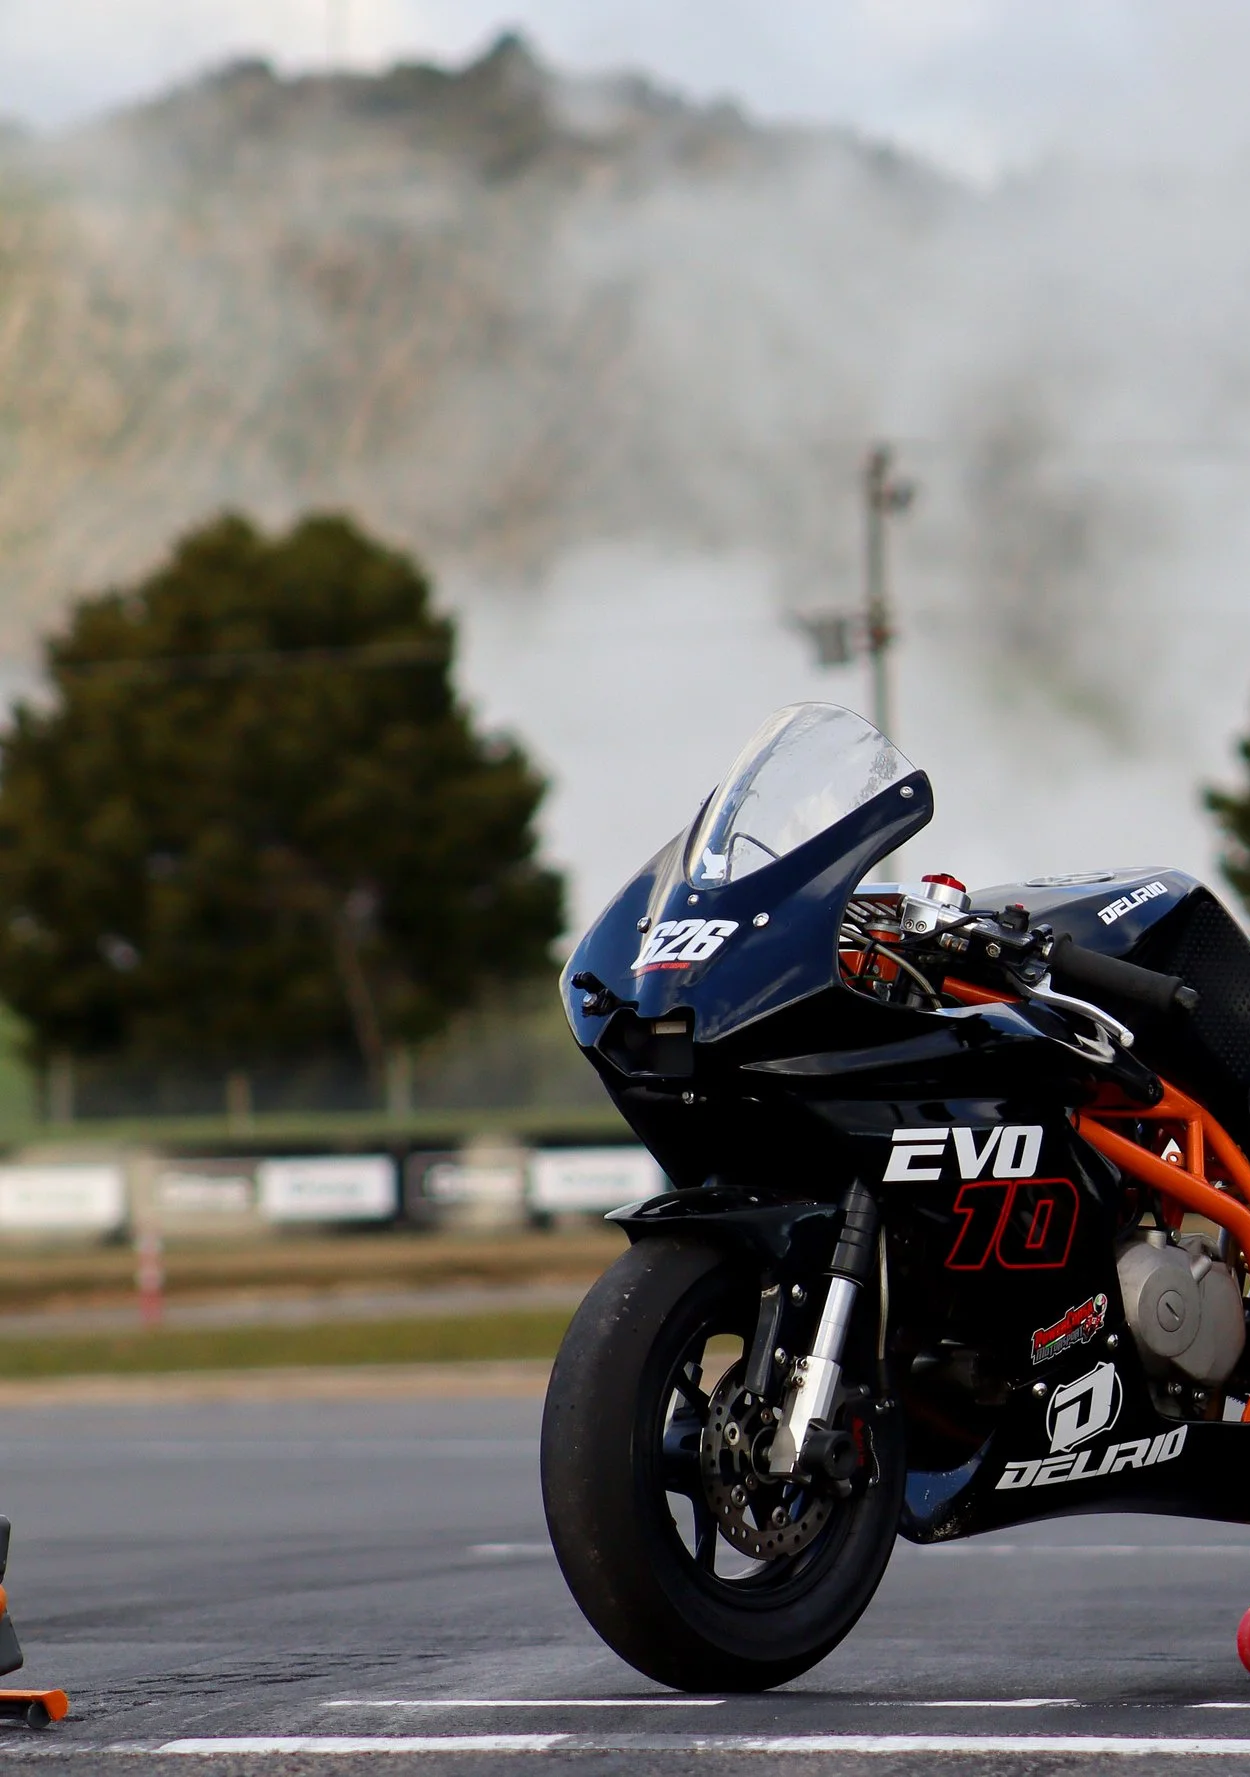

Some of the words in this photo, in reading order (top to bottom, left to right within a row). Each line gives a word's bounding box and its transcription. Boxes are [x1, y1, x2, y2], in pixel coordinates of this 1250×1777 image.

[1097, 881, 1168, 926] DELIRIO
[630, 918, 740, 970] 626
[882, 1125, 1043, 1182] EVO
[944, 1178, 1080, 1270] 10
[995, 1424, 1189, 1490] DELIRIO
